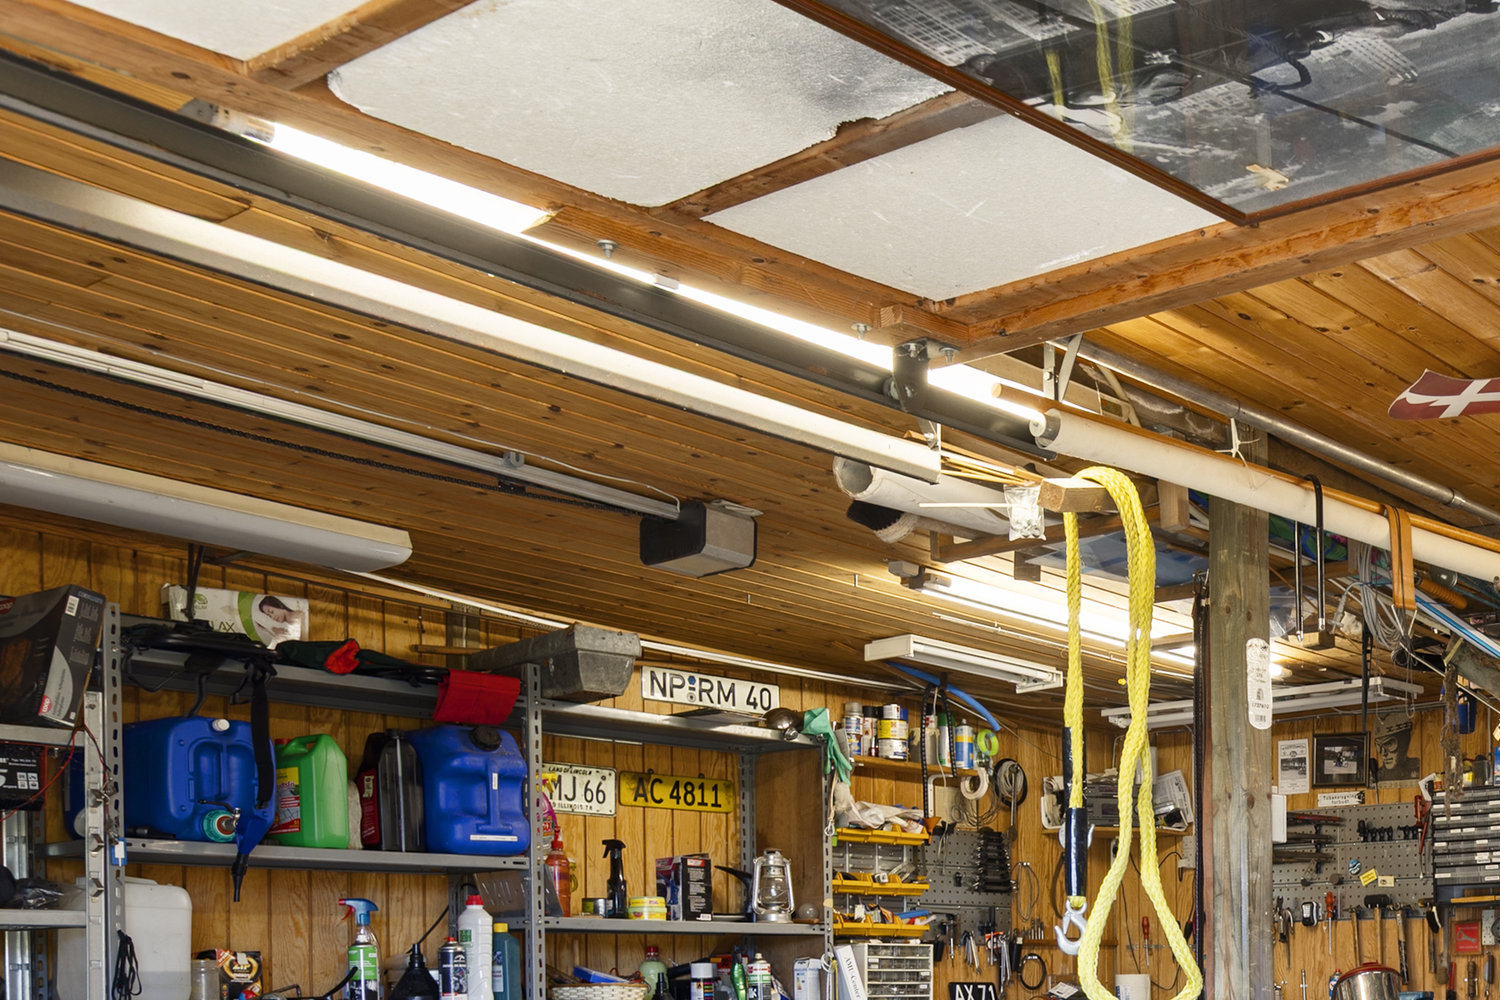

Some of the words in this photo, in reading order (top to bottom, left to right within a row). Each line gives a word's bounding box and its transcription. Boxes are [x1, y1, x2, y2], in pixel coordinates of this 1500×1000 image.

[746, 685, 772, 711] 40
[584, 780, 606, 804] 66
[633, 777, 664, 804] AC
[669, 780, 722, 808] 4811
